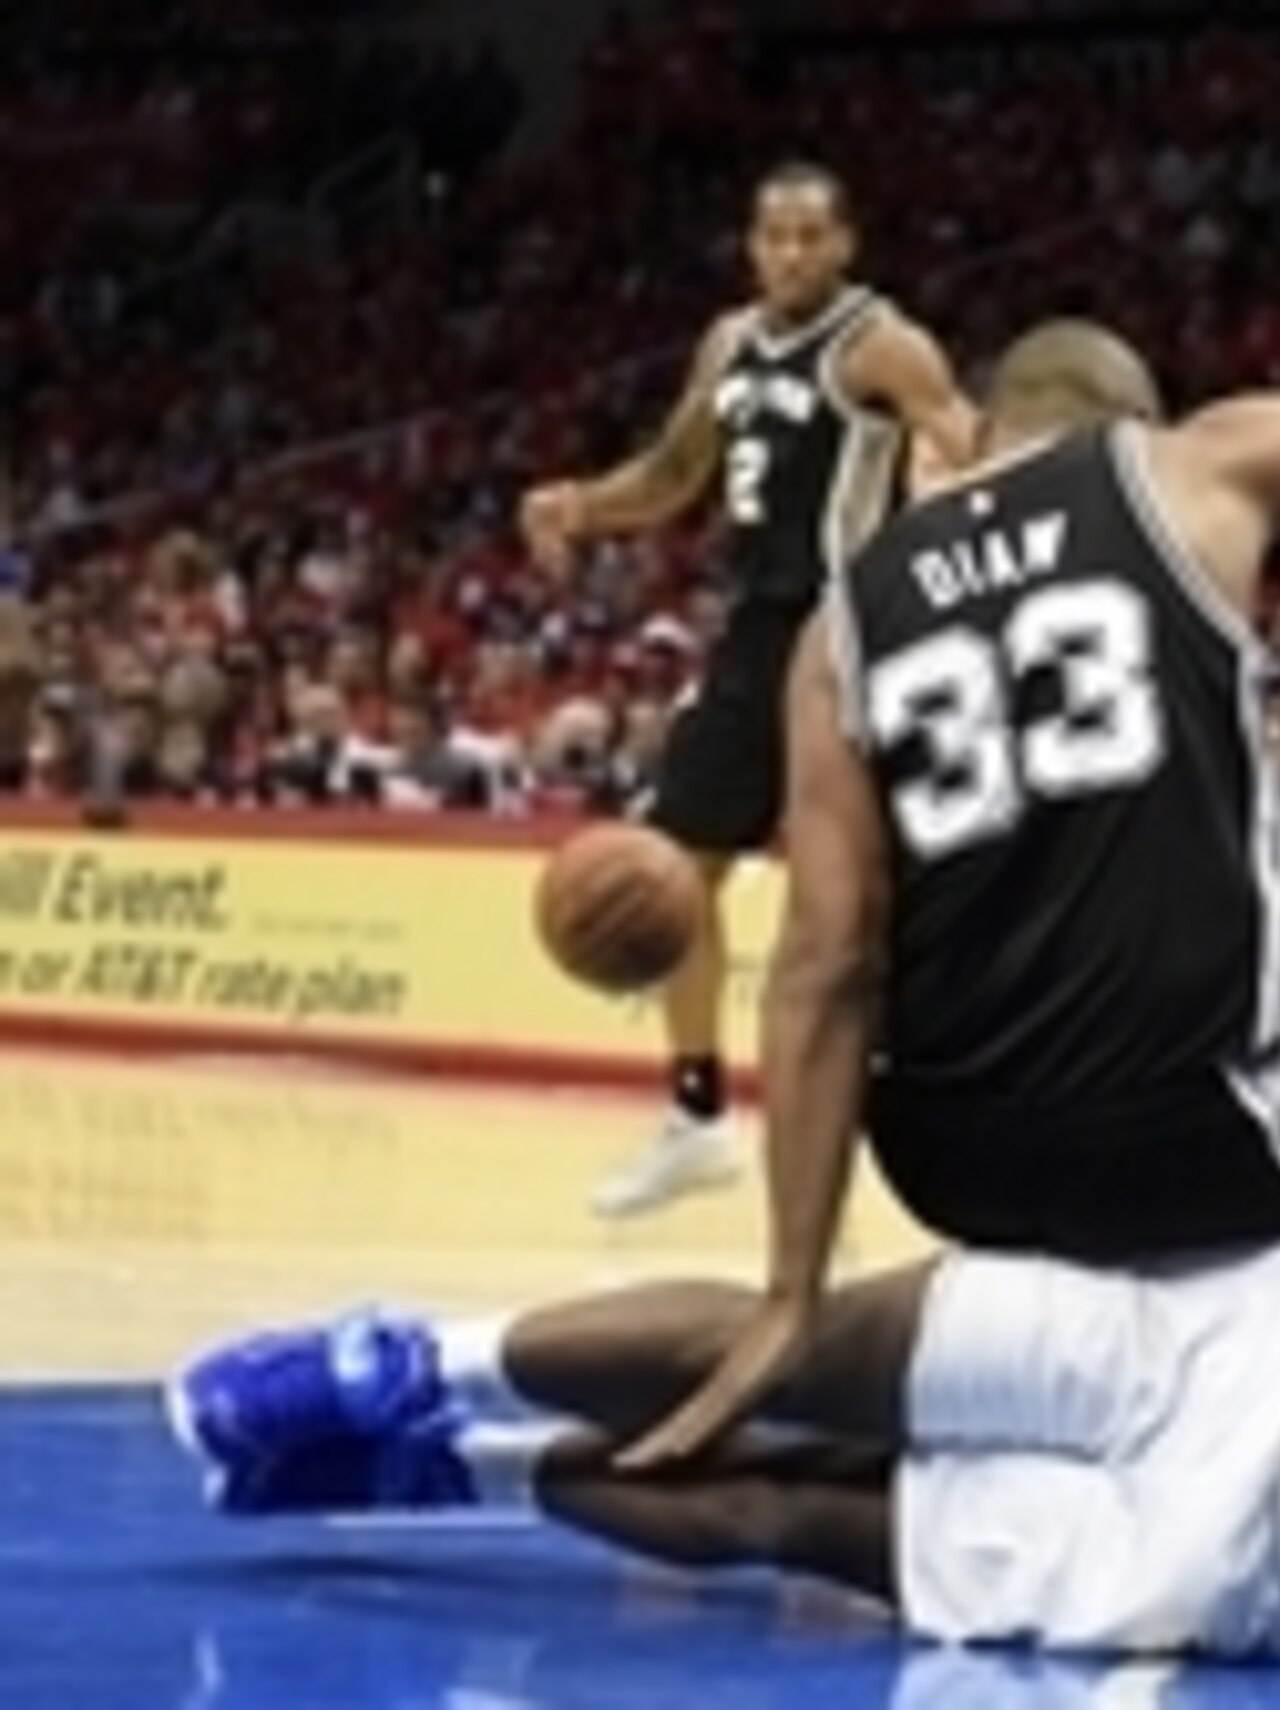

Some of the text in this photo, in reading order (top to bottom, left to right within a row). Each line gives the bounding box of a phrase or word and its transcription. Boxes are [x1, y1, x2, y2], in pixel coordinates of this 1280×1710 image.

[726, 434, 769, 523] 2
[866, 574, 1167, 860] 33
[54, 849, 230, 934] Event.
[197, 955, 293, 1014] rate
[288, 954, 408, 1026] plan
